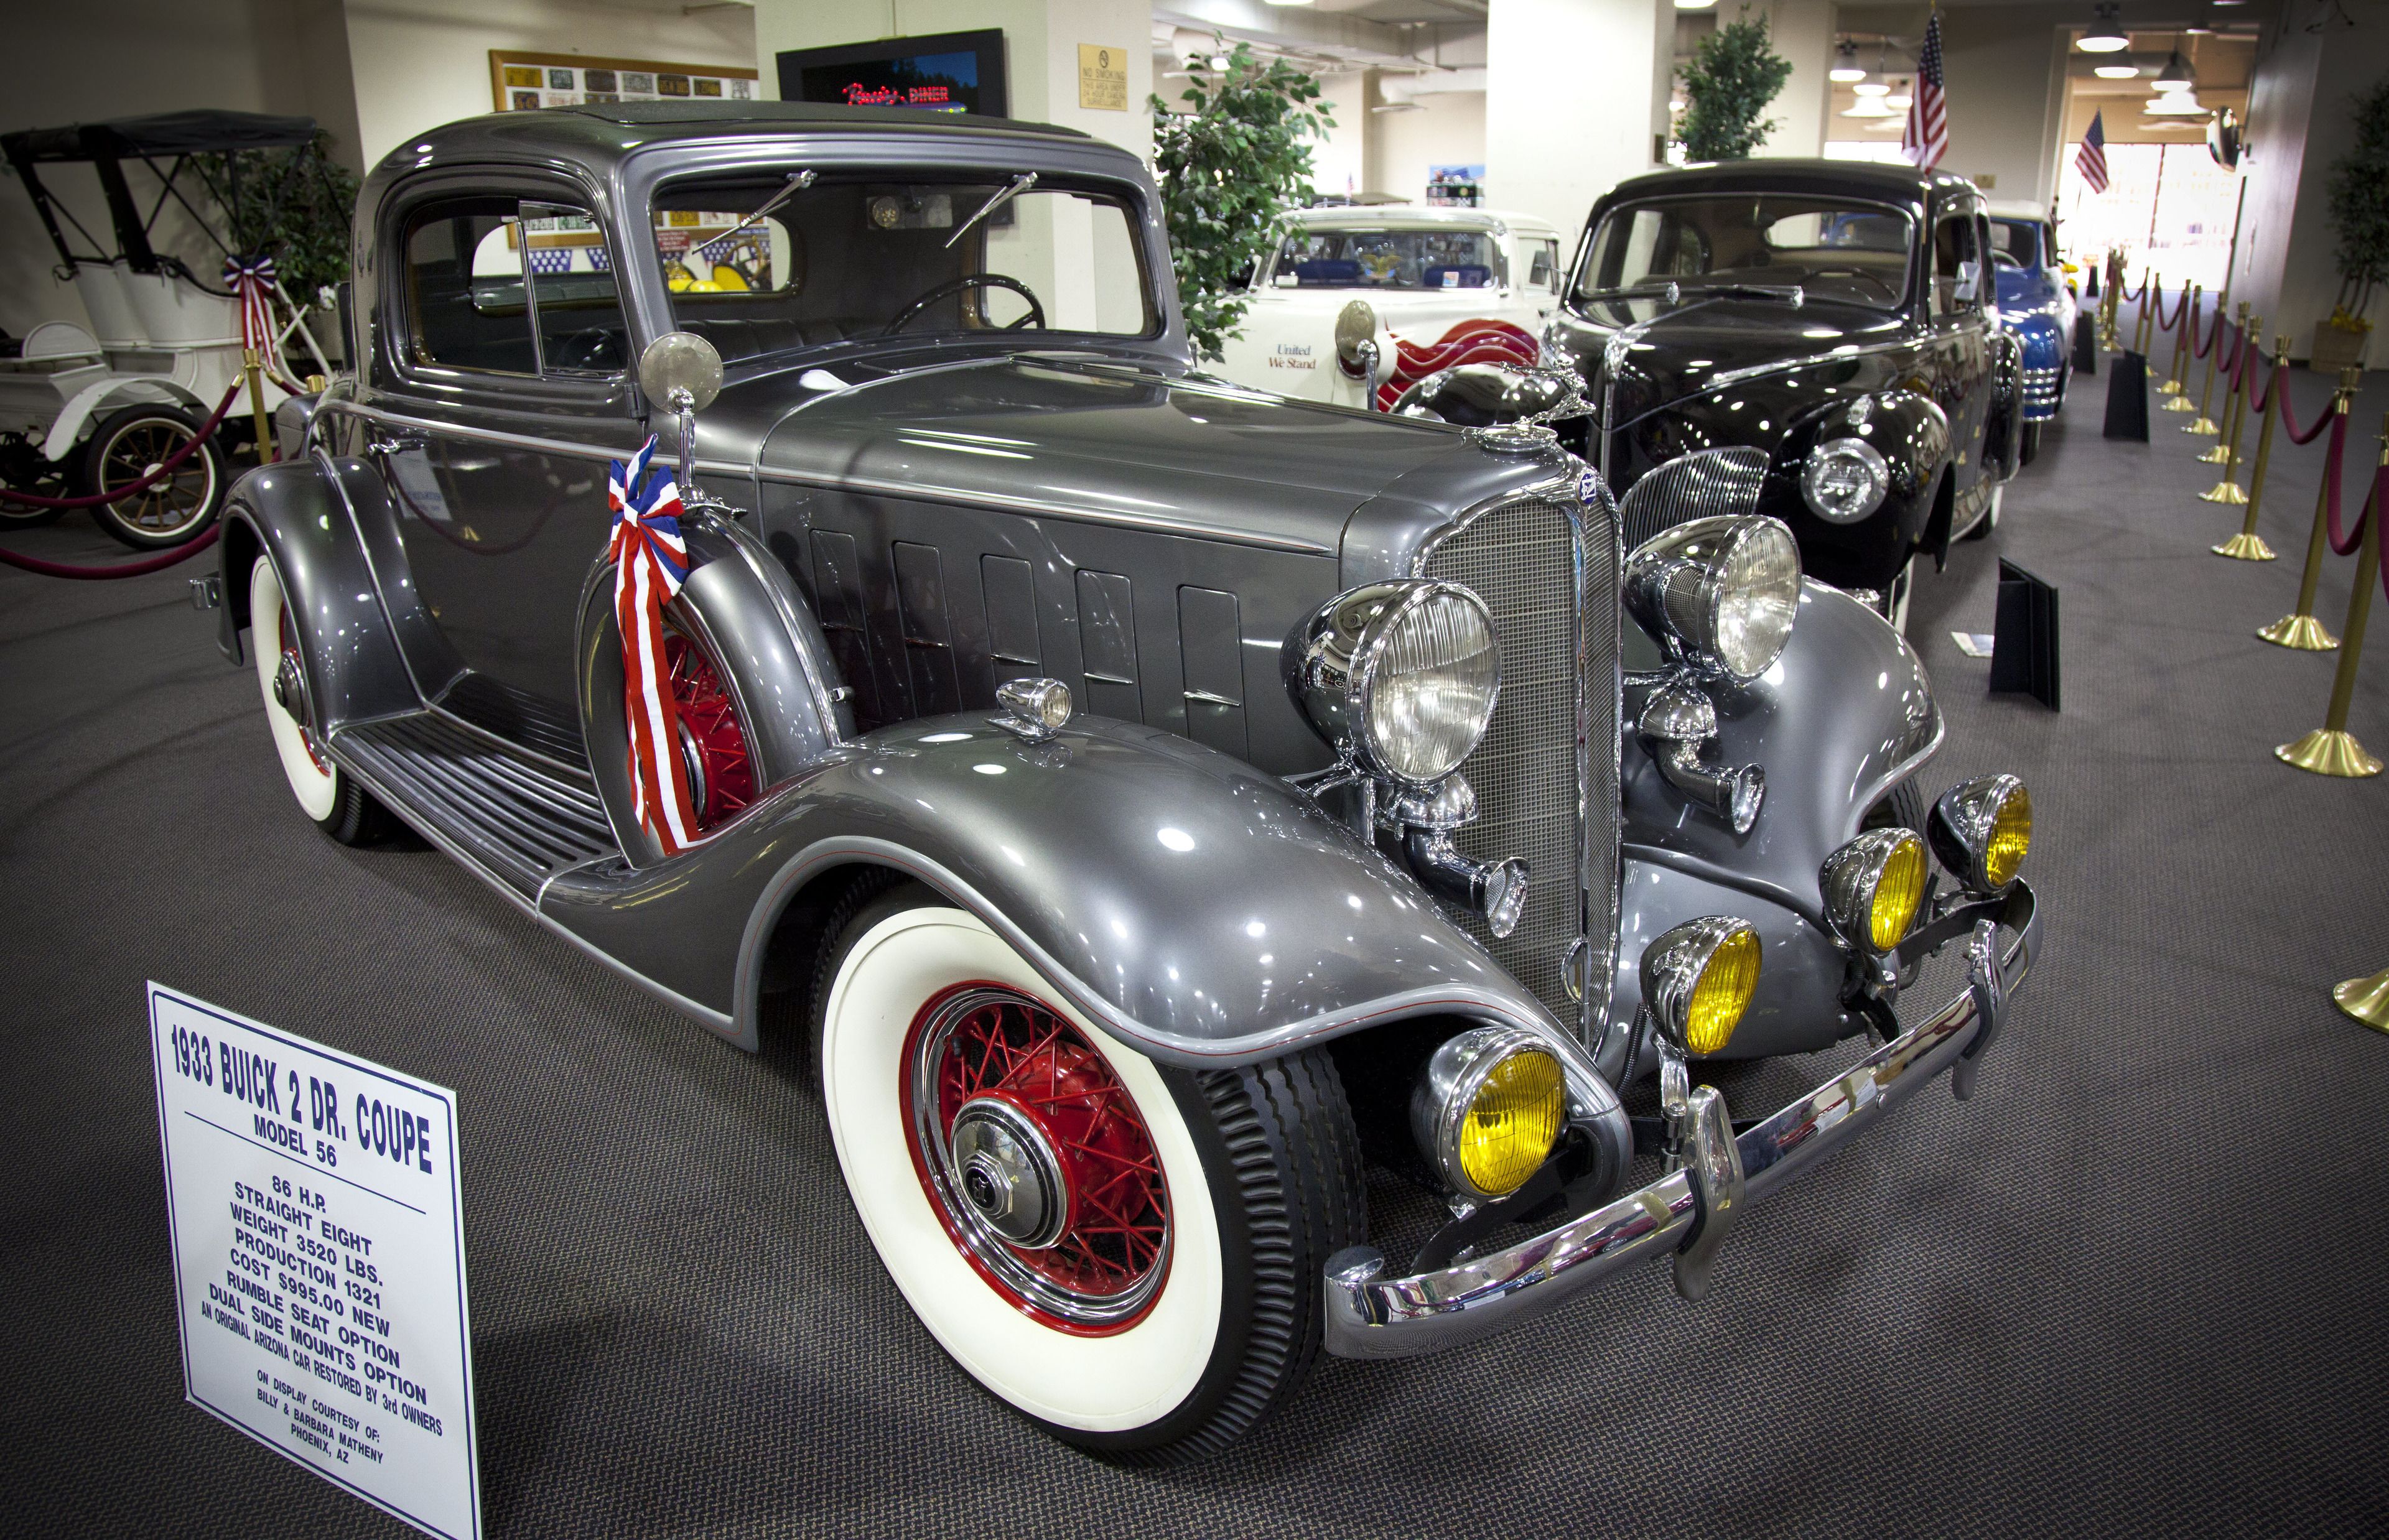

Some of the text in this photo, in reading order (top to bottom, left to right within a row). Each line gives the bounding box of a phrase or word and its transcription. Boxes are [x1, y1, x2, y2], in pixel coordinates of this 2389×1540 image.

[909, 86, 949, 103] DINER
[1269, 356, 1316, 369] We Stand
[1277, 343, 1311, 356] United
[171, 1024, 432, 1175] 1933 BUICK 2 DR. COUPE
[254, 1113, 337, 1167] MODEL 56
[235, 1181, 372, 1256] STRAIGHT EIGHT
[272, 1175, 326, 1213] 86 H.P.
[230, 1202, 383, 1287] WEIGHT 3520 LBS.
[235, 1227, 381, 1310] PRODUCTION 1321
[227, 1269, 400, 1369] RUMBLE SEAT OPTION
[230, 1248, 390, 1337] COST $995.00 NEW
[202, 1301, 443, 1437] AN ORIGINAL ARIZONA CAR RESTORED BY 3rd OWNERS
[209, 1283, 427, 1406] DUAL SIDE MOUNTS OPTION
[257, 1369, 380, 1443] ON DISPLAY COURTESY OF:
[257, 1388, 384, 1464] BILLY & BARBARA MATHENY
[291, 1423, 349, 1464] PHOENIX, AZ
